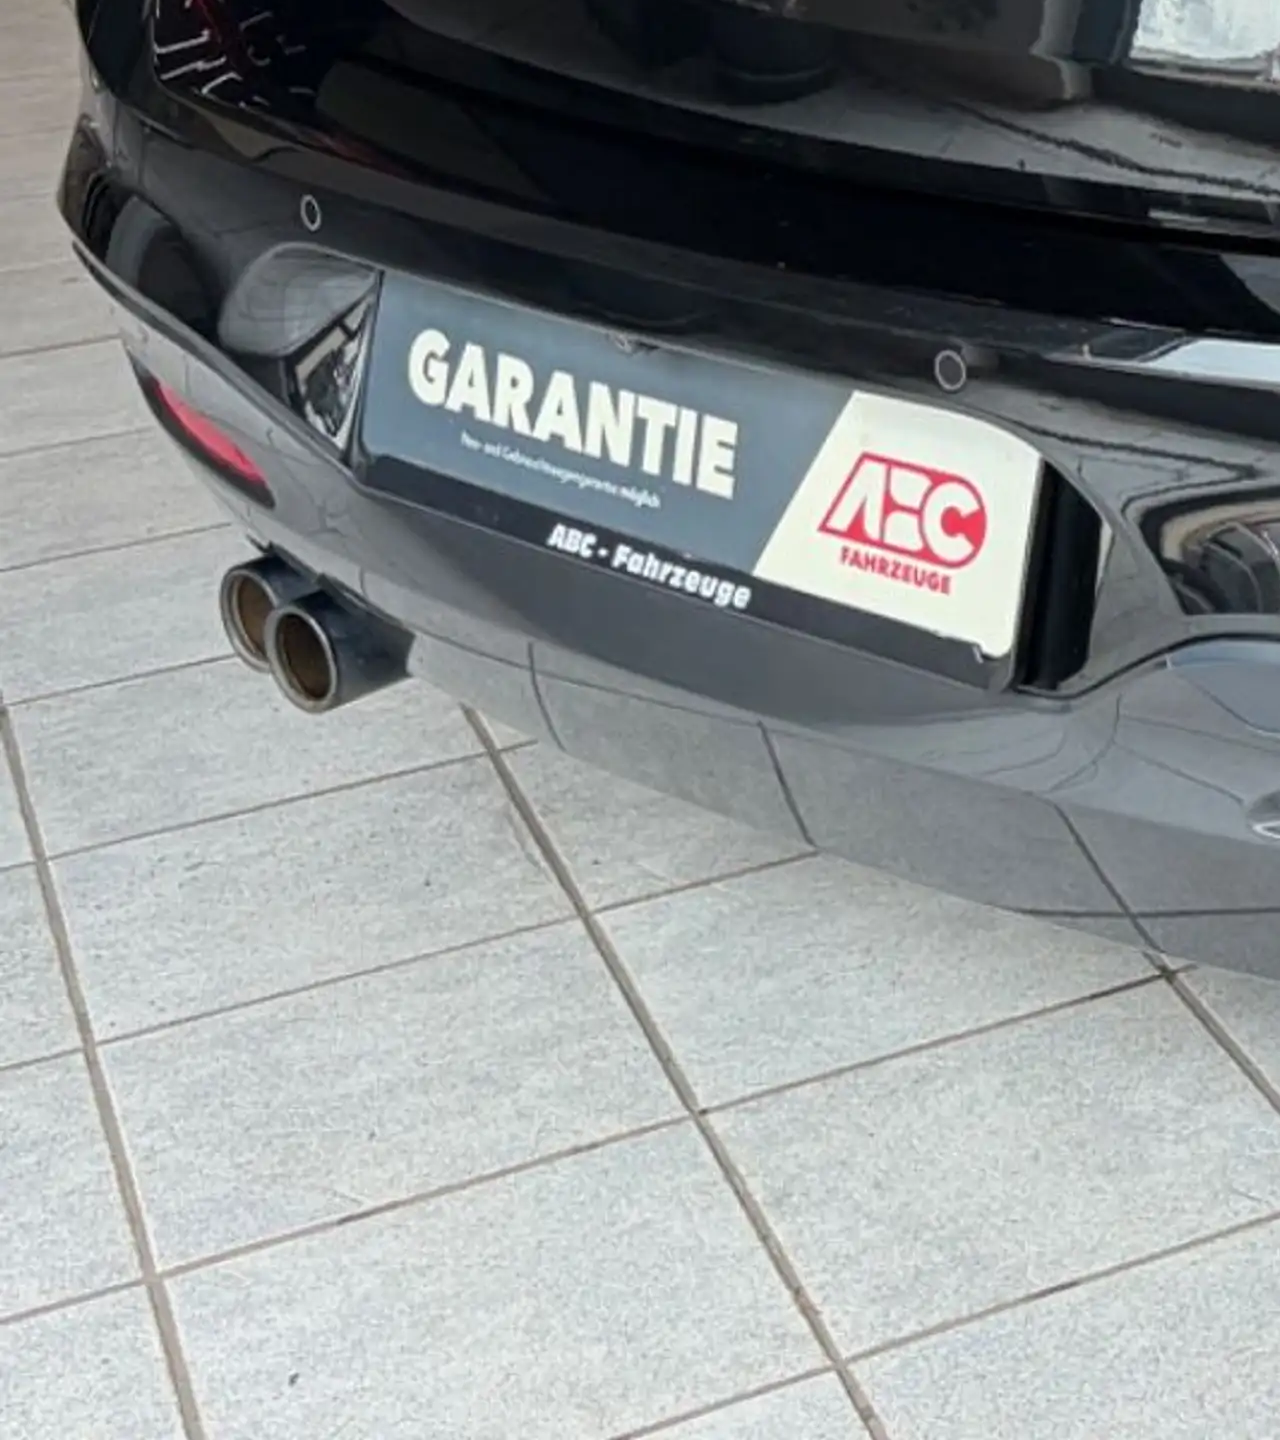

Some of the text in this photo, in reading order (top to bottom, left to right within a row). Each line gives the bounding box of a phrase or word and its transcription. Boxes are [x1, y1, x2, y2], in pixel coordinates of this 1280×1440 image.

[408, 328, 739, 500] GARANTIE
[547, 523, 597, 558] ABC
[610, 543, 752, 610] Fahrzeuge
[840, 545, 951, 595] FAHRZEUGE
